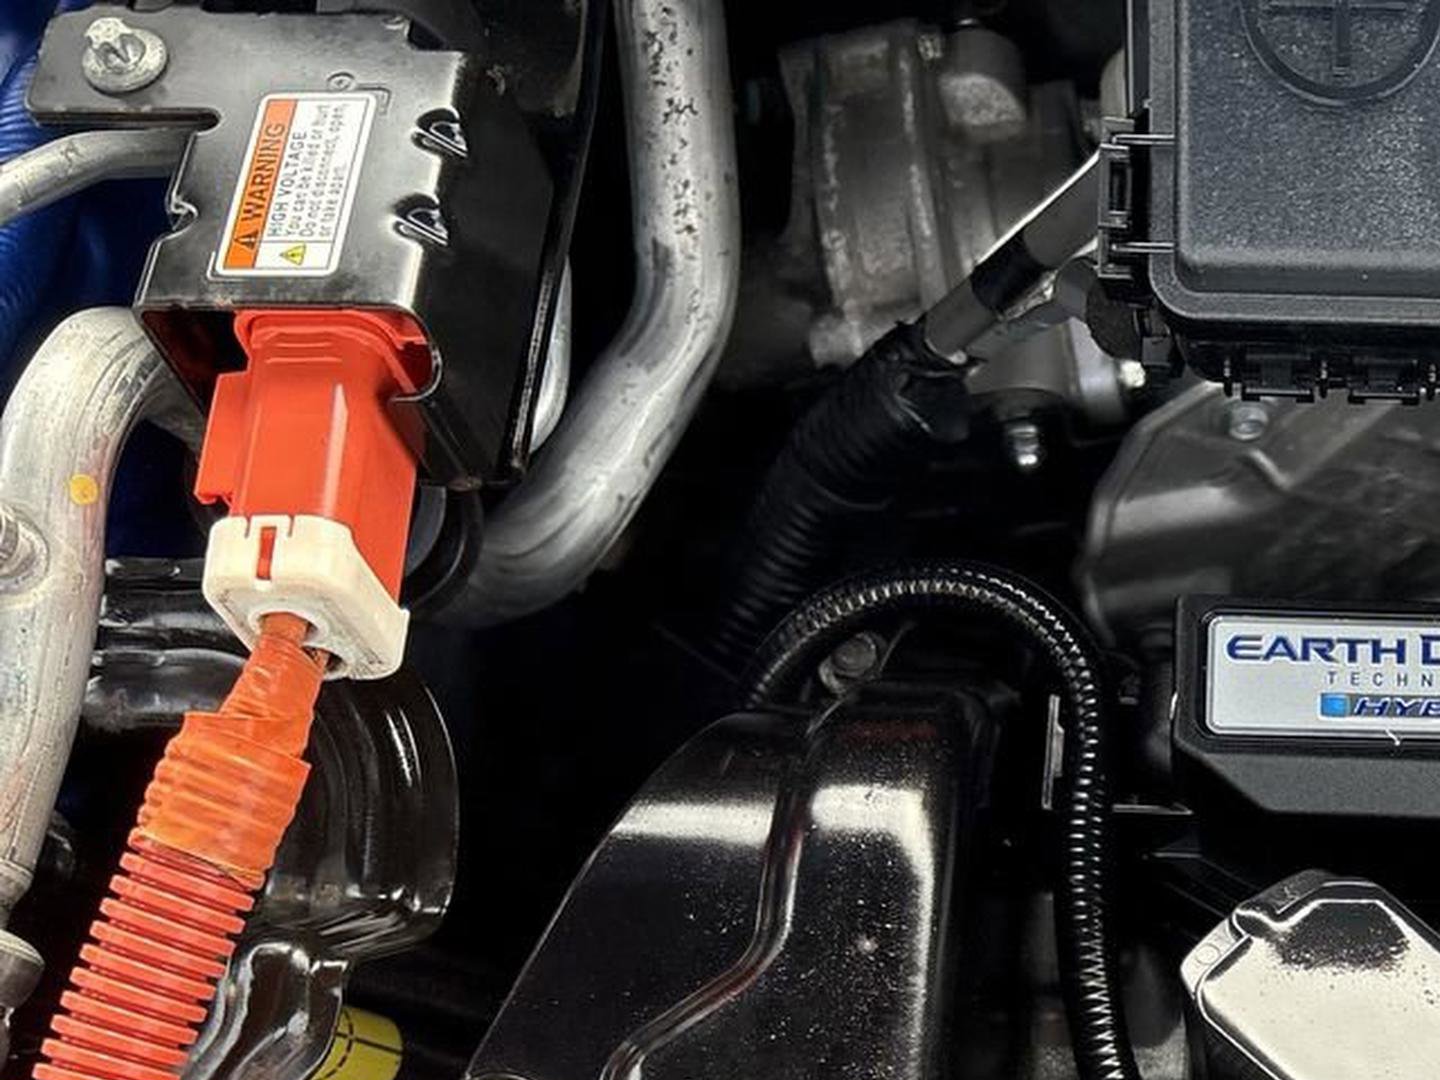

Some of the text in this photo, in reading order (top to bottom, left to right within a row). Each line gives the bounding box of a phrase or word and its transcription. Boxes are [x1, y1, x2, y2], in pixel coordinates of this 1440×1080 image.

[242, 122, 285, 221] WARNING
[267, 131, 307, 237] HIGH VOLTAGE
[296, 176, 311, 190] be
[292, 192, 307, 212] can
[304, 199, 322, 219] not
[319, 198, 338, 224] take
[286, 215, 302, 237] You
[300, 222, 315, 237] Do
[1226, 633, 1407, 665] EARTH
